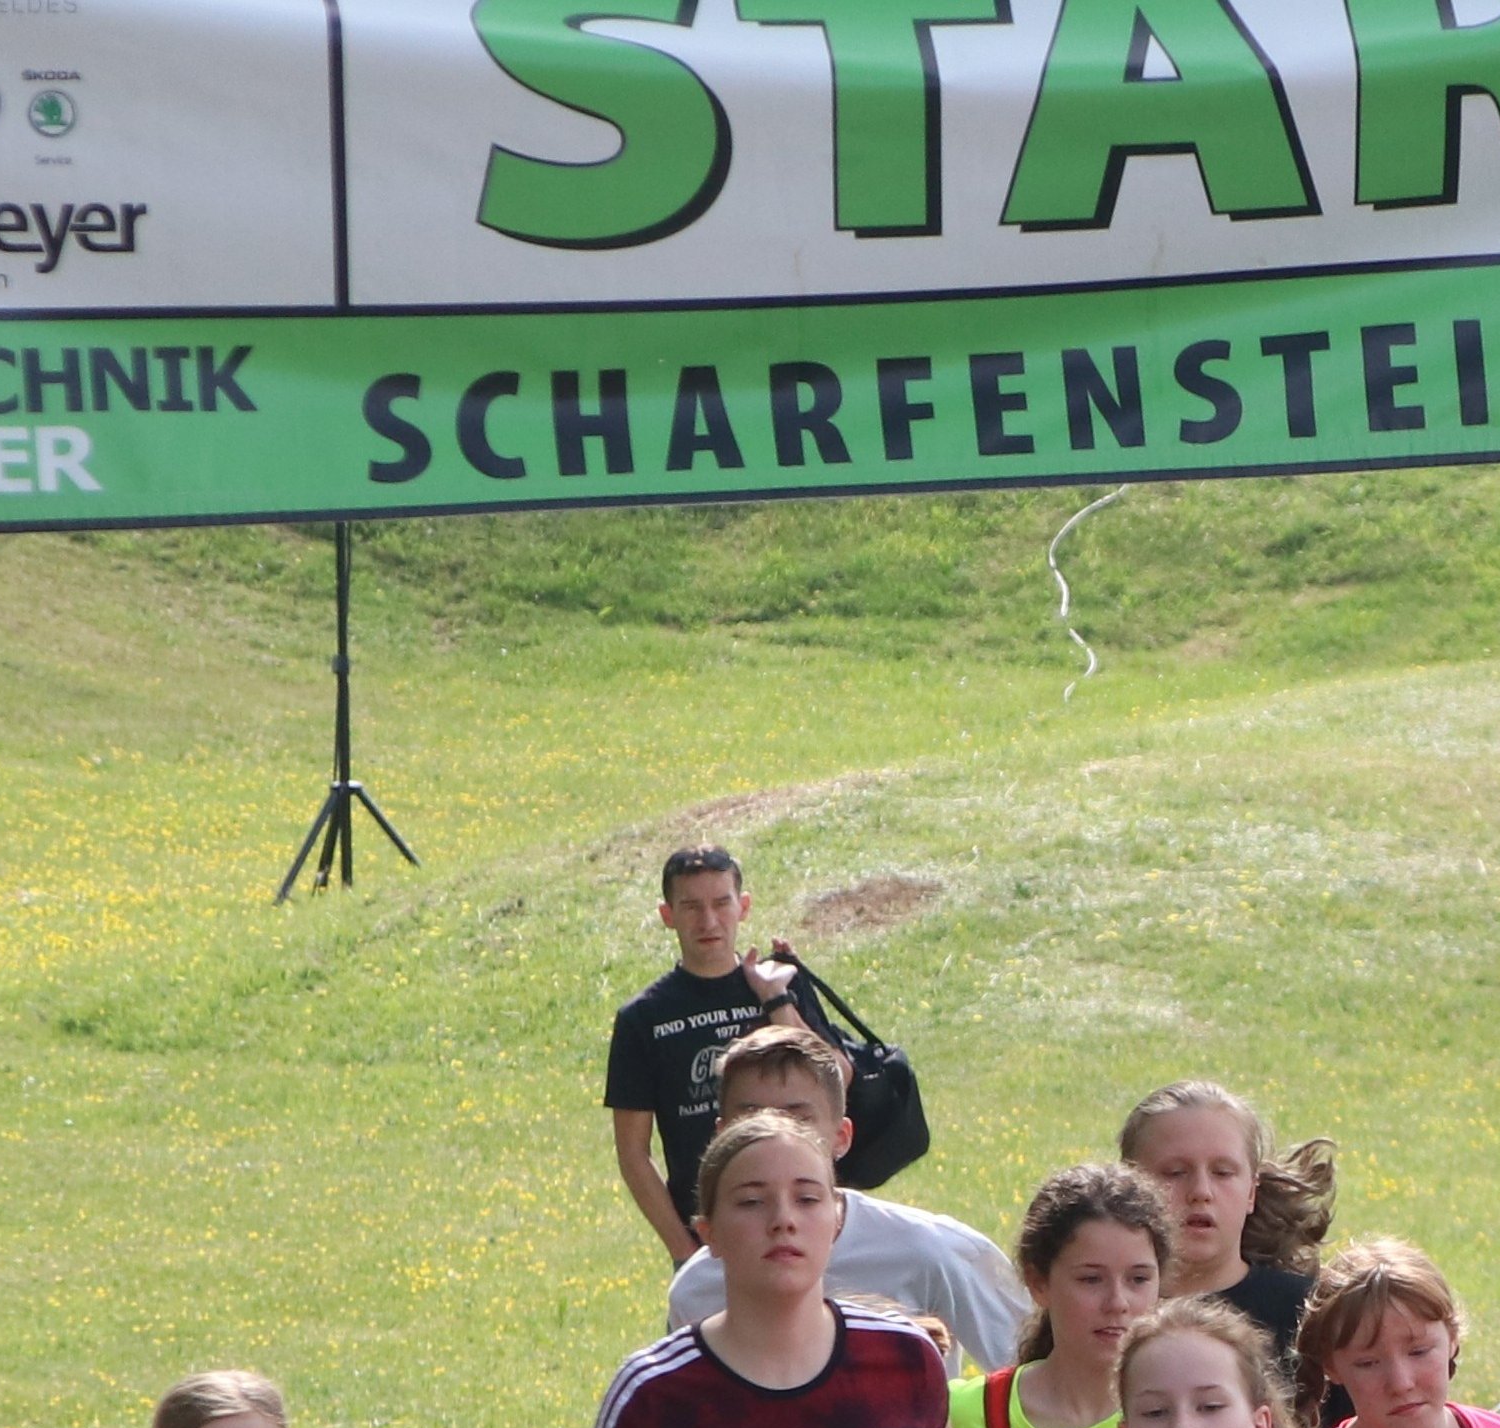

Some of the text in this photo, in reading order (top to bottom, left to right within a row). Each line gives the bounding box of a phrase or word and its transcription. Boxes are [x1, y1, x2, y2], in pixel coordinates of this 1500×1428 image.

[653, 1020, 686, 1039] FIND
[687, 1009, 728, 1029] YOUR
[715, 1024, 741, 1039] 1977
